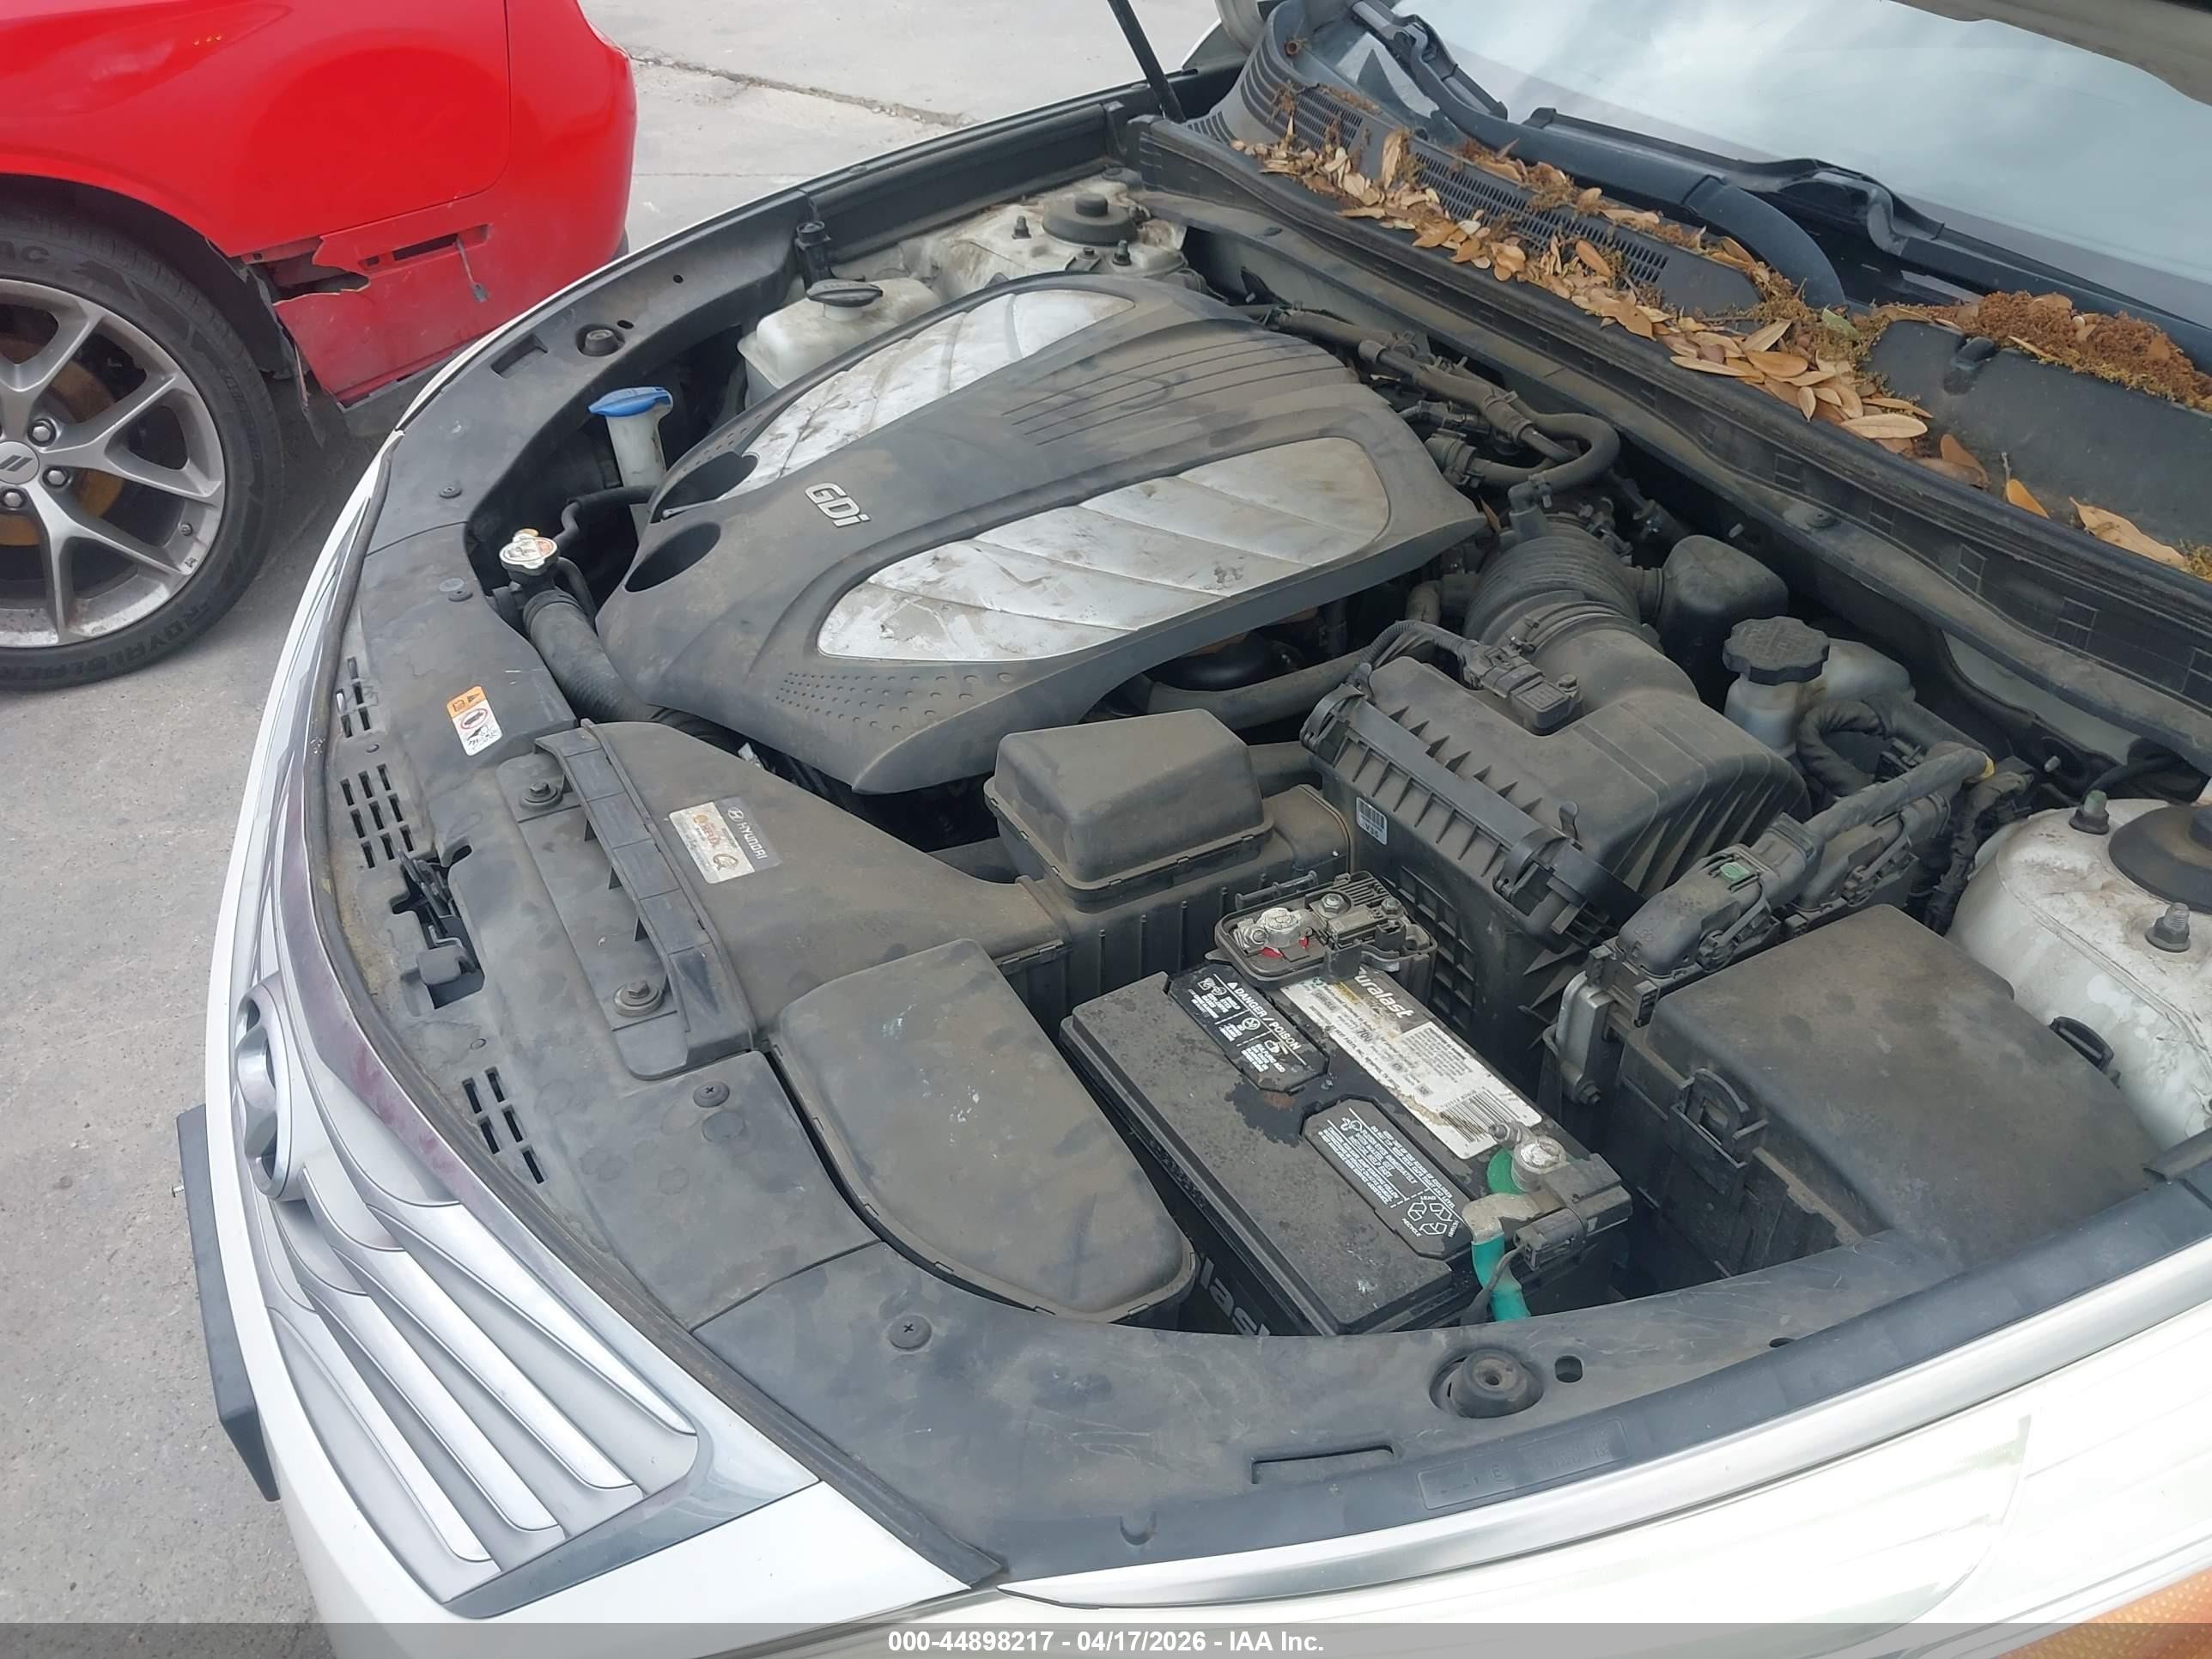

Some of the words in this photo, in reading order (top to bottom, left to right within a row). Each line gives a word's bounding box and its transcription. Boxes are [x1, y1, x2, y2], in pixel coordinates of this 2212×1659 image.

[805, 483, 871, 527] GDi
[737, 822, 769, 860] HYUNDAI
[1234, 988, 1267, 1017] DANGER
[1268, 1021, 1301, 1049] POISON
